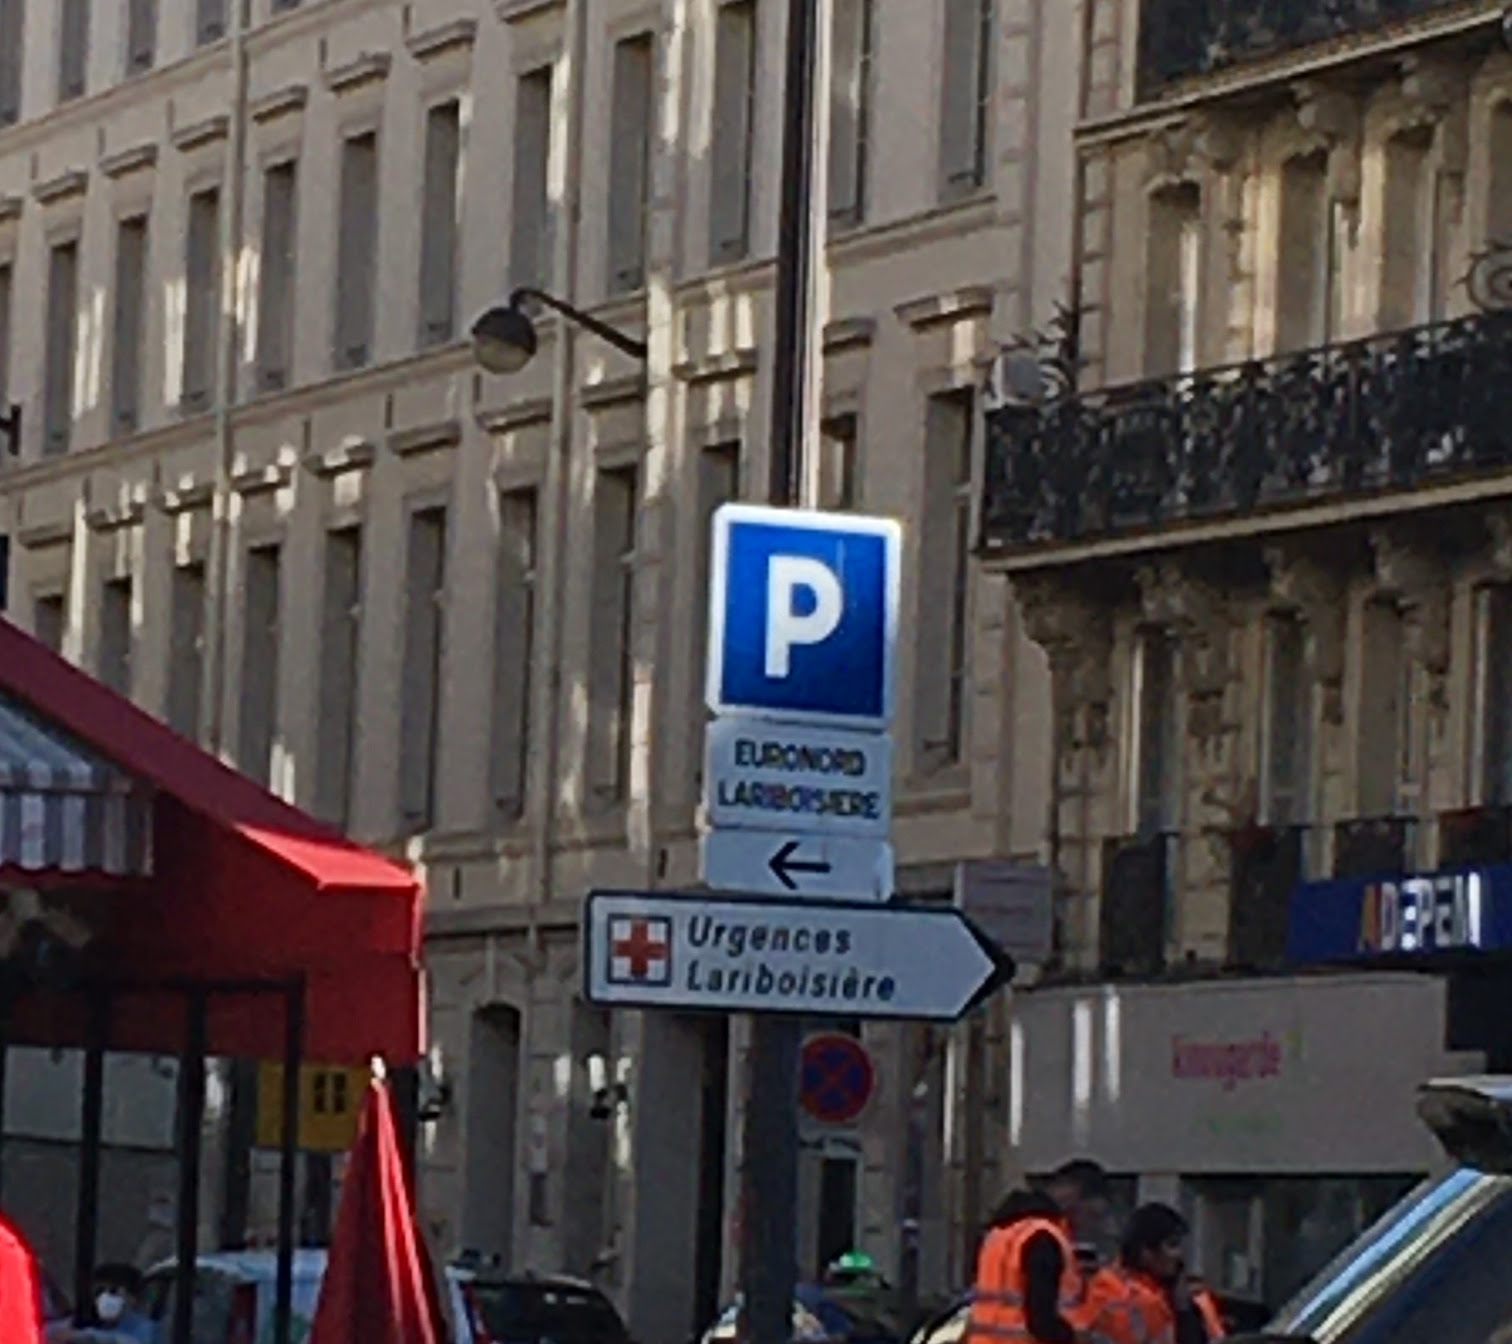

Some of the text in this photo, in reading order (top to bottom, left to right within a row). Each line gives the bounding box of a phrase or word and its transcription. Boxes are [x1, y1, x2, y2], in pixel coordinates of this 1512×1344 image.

[765, 554, 843, 678] P
[734, 738, 867, 777] EURONORD
[688, 915, 852, 958] Urgences
[687, 959, 896, 1001] Lariboisière
